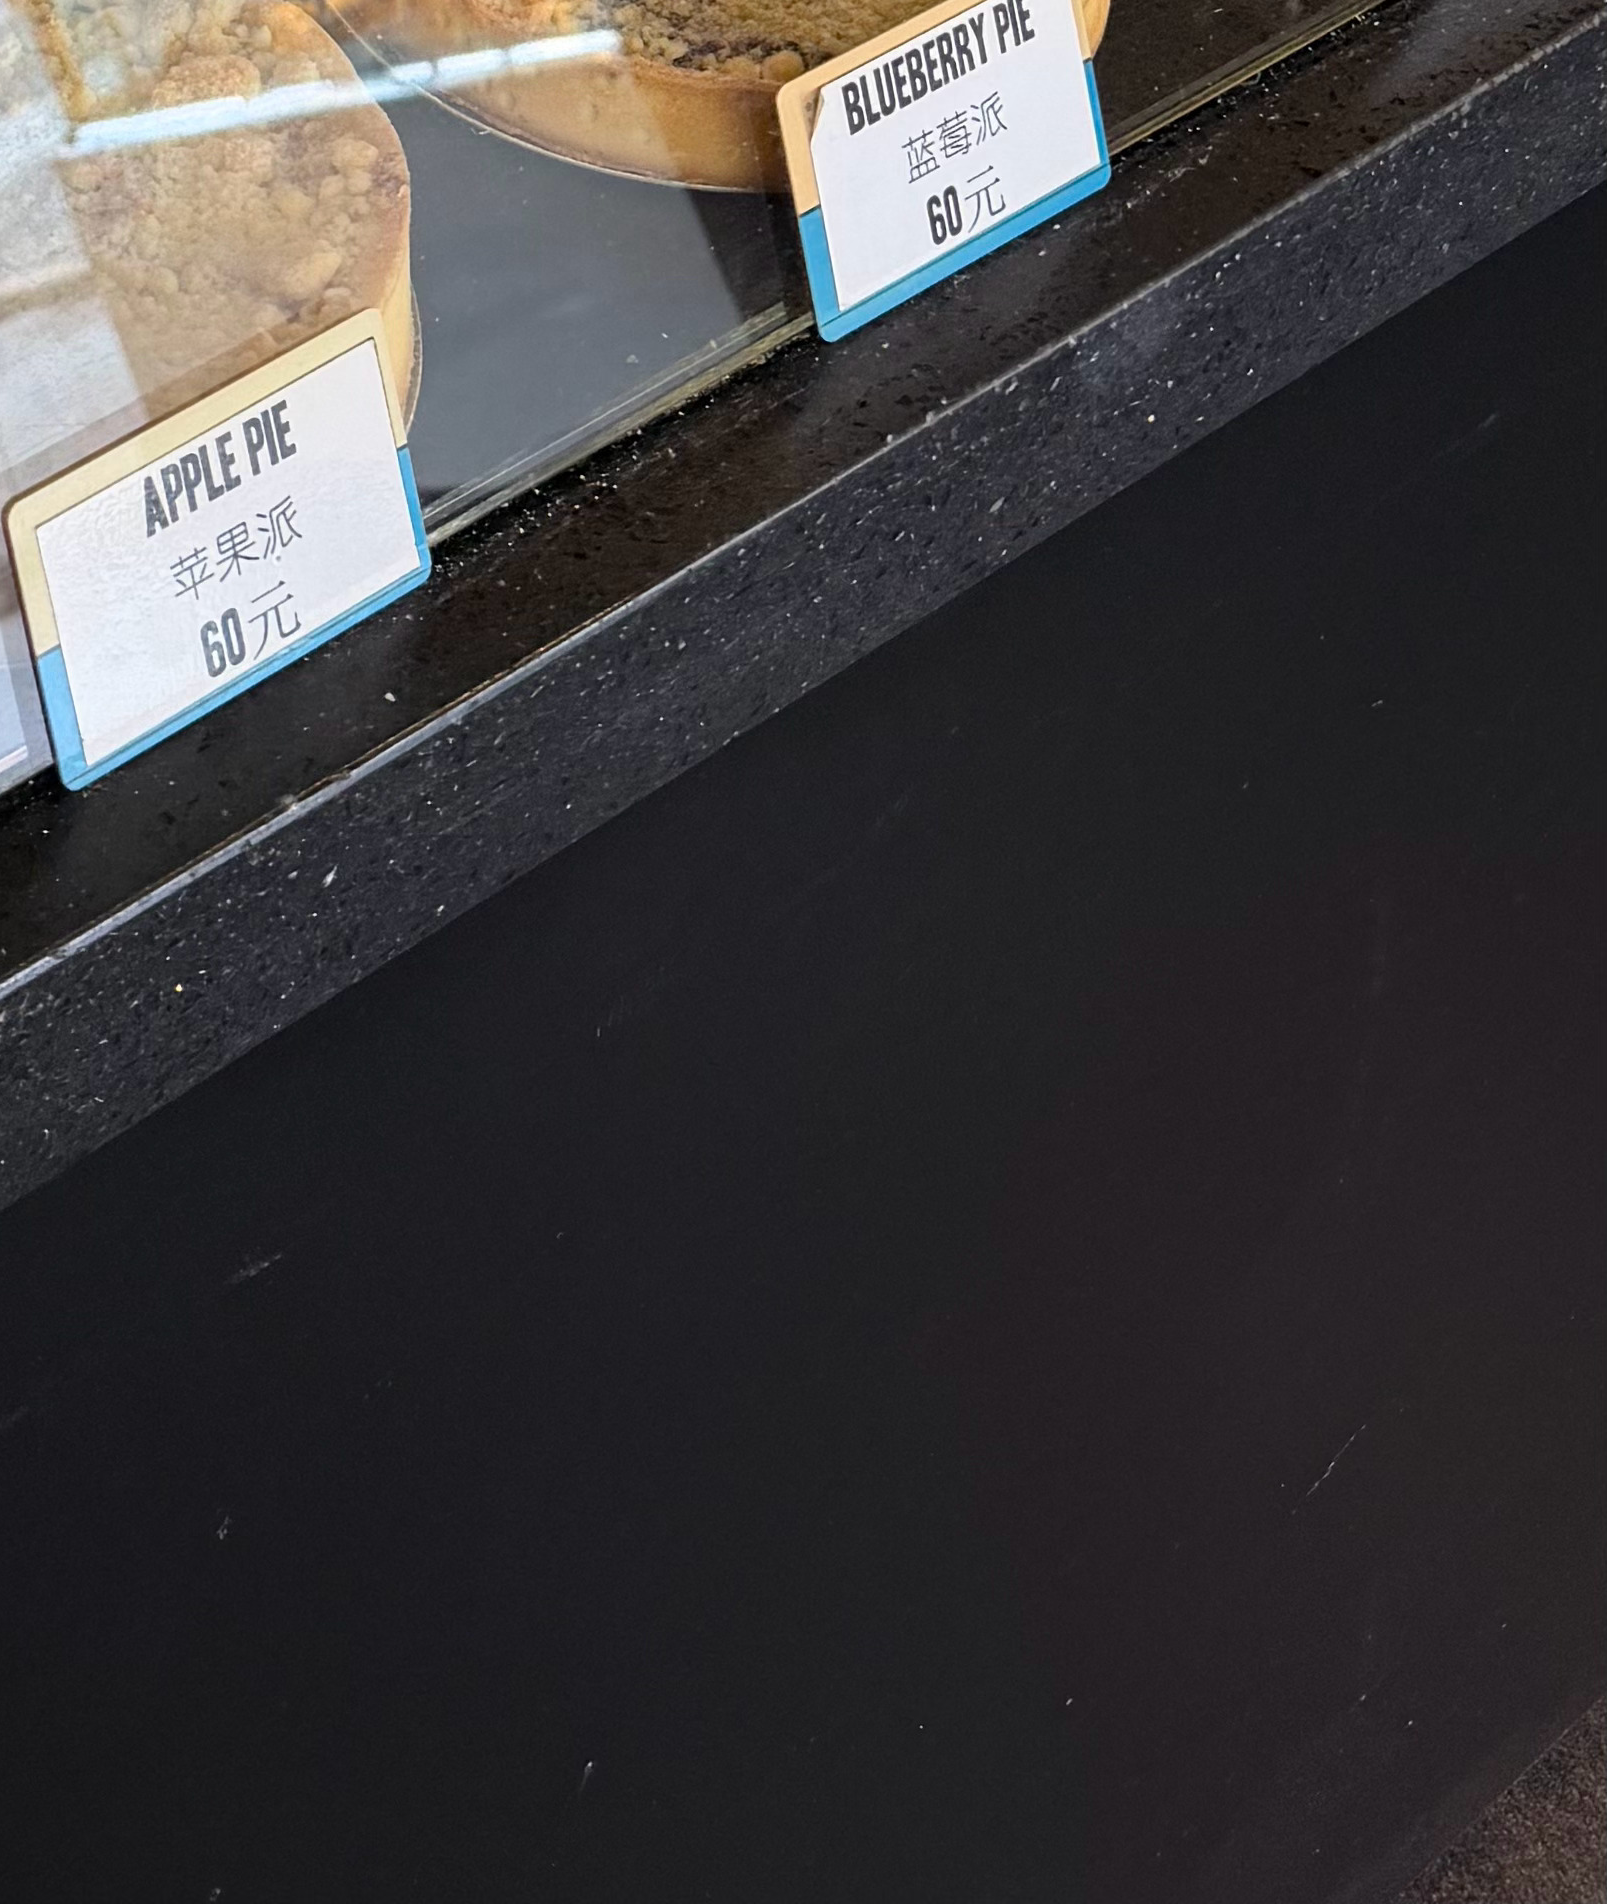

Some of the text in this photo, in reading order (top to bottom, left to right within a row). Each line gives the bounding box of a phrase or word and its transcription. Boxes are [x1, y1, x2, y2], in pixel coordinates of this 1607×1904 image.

[842, 16, 987, 134] BLUEBERRY
[902, 92, 1008, 184] 蓝莓派
[927, 165, 1006, 246] 60元
[143, 400, 297, 537] APPLE PIE
[169, 495, 303, 600] 苹果派
[201, 580, 302, 678] 60元
